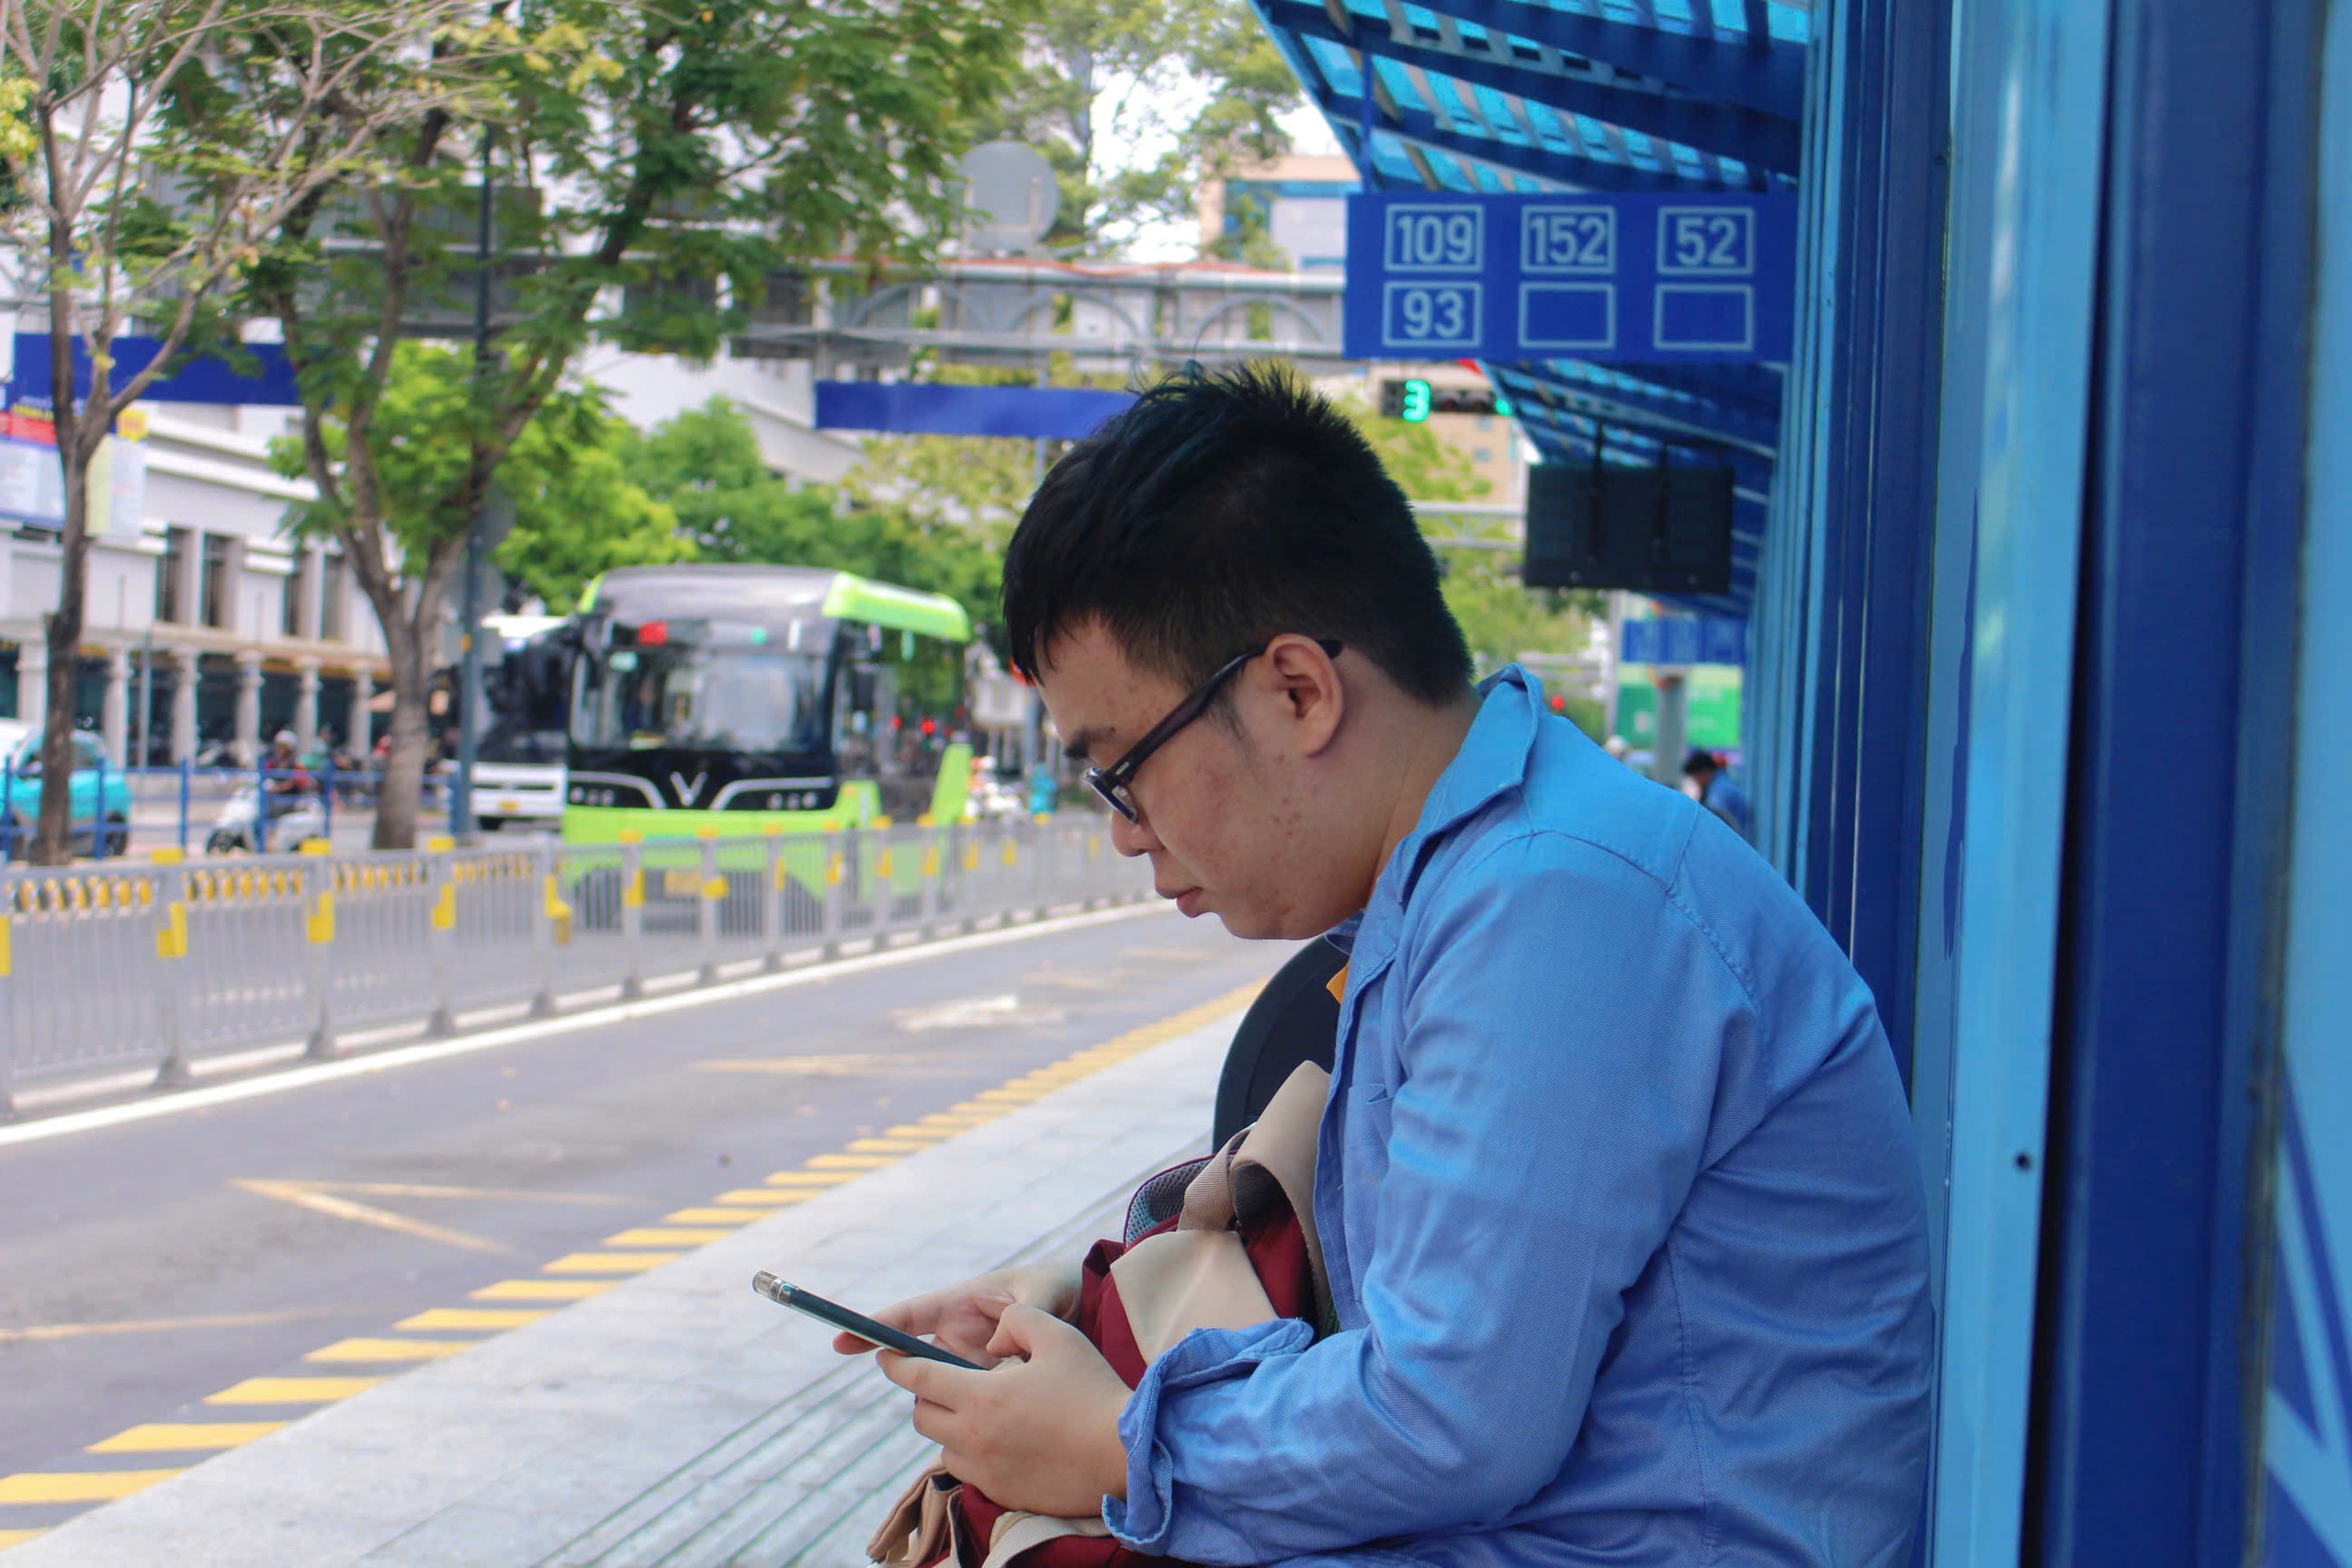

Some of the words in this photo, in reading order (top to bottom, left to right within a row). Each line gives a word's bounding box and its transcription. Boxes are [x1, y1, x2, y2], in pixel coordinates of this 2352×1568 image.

[1396, 215, 1474, 264] 109
[1529, 215, 1607, 265] 152
[1676, 216, 1737, 266] 52
[1402, 289, 1464, 339] 93
[1403, 378, 1430, 423] 3
